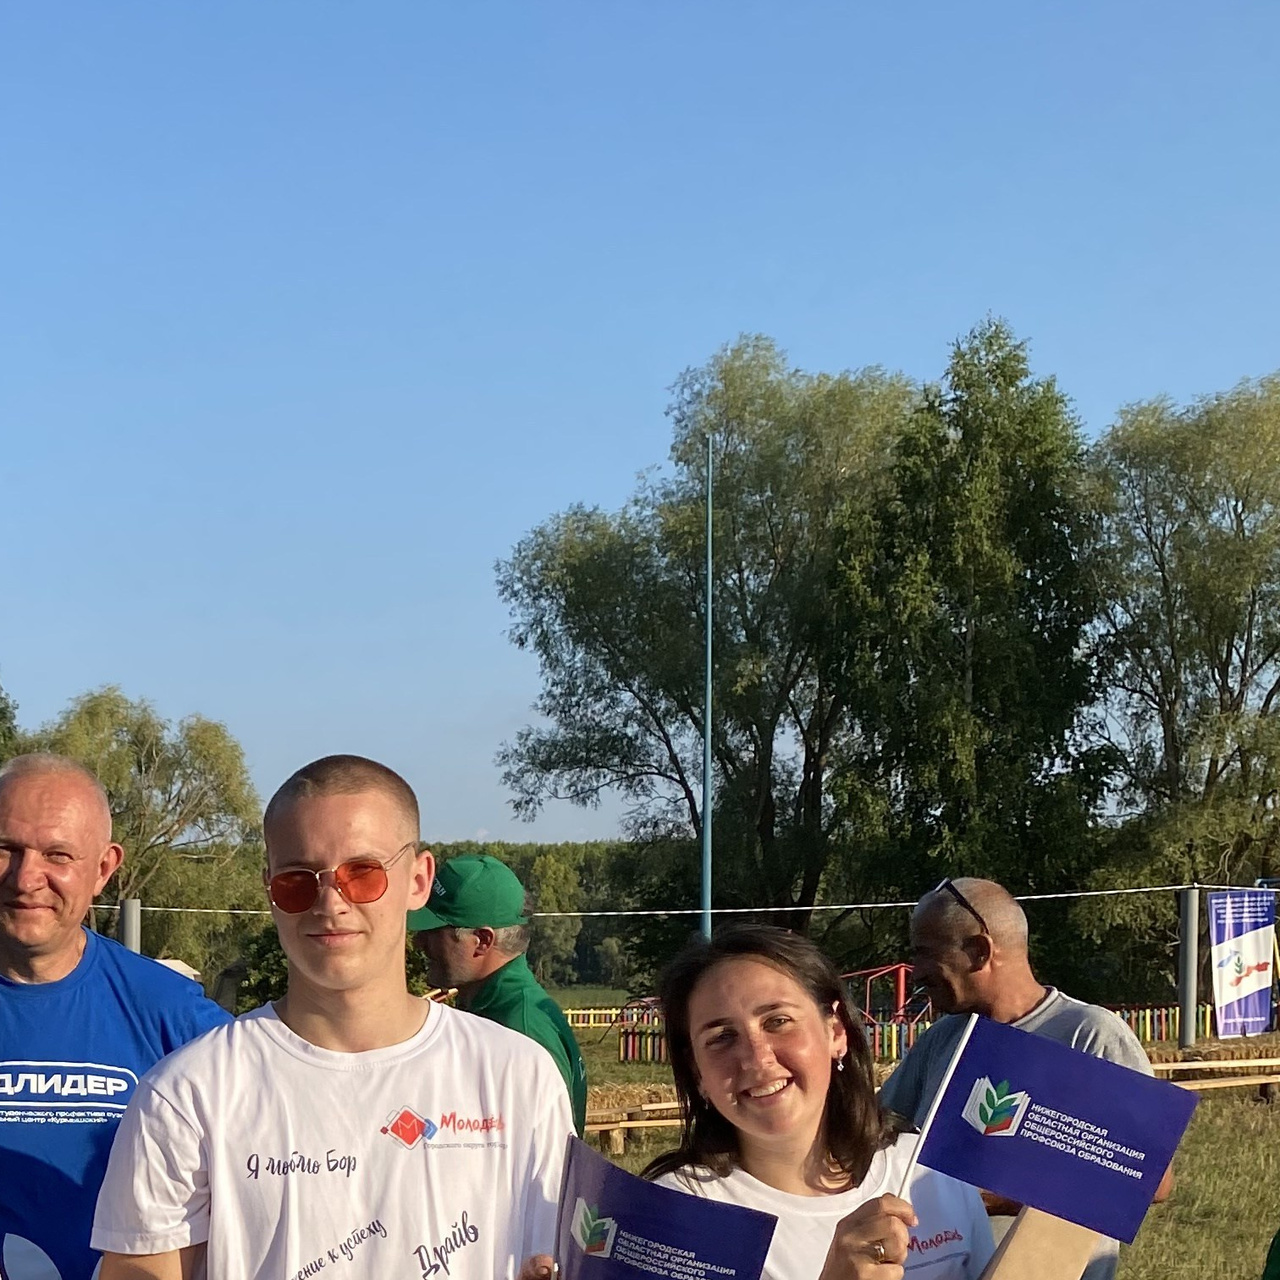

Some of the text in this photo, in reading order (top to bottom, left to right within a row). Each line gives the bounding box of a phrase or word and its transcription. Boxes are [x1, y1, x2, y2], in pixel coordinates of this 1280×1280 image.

[1027, 1112, 1146, 1161] ОБЛАСТНАЯ ОРГАНИЗАЦИЯ
[1031, 1103, 1108, 1137] НИЖЕГОРОДСКАЯ
[1020, 1128, 1143, 1180] ПРОФСОЮЗА ОБРАЗОВАНИЯ
[1024, 1121, 1114, 1159] ОБЩЕРОССИЙСКОГО
[246, 1154, 259, 1179] Я
[326, 1149, 357, 1178] Бор
[327, 1249, 339, 1264] к
[616, 1245, 706, 1277] ОБЩЕРОССИЙСКОГО
[617, 1237, 736, 1277] ОБЛАСТНАЯ ОРГАНИЗАЦИЯ
[620, 1230, 696, 1259] НИЖЕГОРОДСКАЯ
[613, 1253, 669, 1276] ПРОФСОЮЗА
